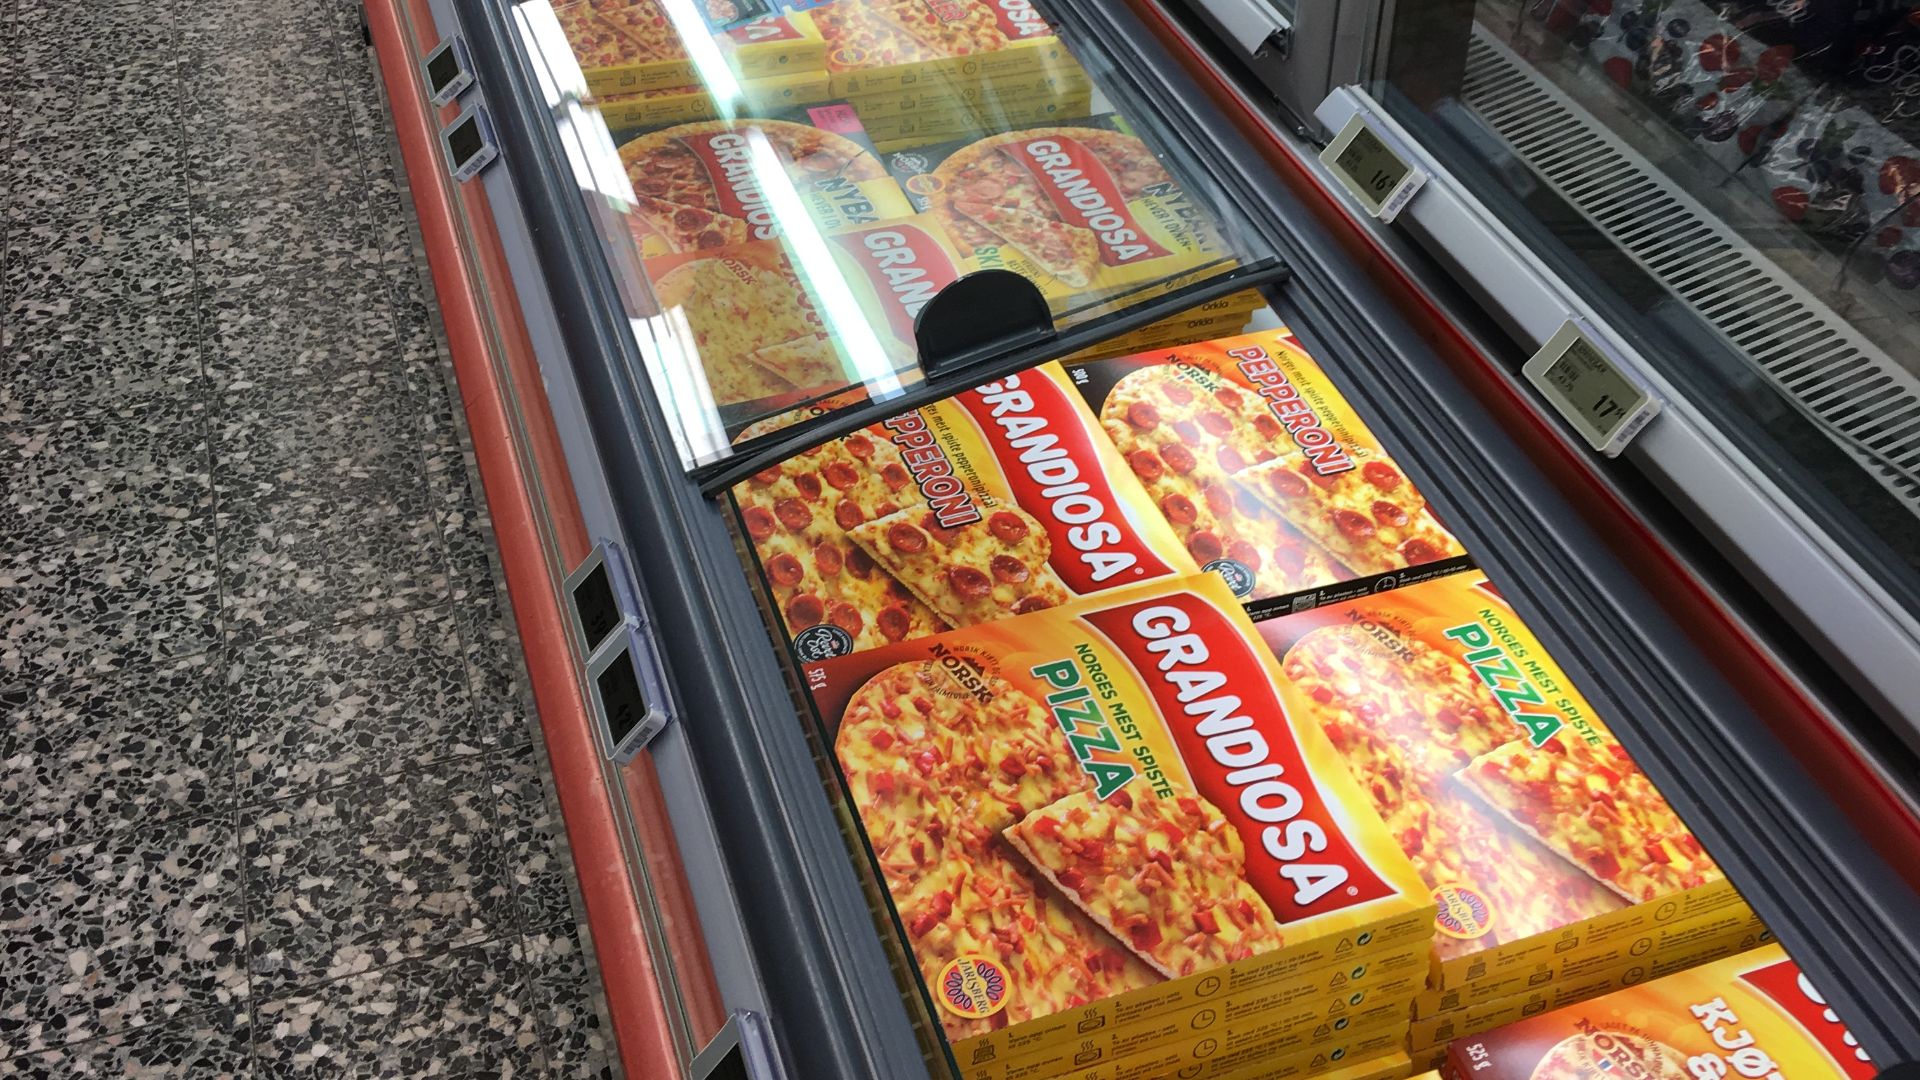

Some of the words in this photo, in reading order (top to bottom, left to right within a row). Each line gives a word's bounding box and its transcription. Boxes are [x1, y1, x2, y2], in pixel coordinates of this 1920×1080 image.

[1026, 139, 1149, 261] GRANDIOSA
[1202, 300, 1229, 311] Orkla
[1165, 354, 1220, 392] NORSK
[1292, 370, 1311, 386] mest
[934, 415, 951, 433] mest
[942, 430, 962, 452] spiste
[1227, 345, 1357, 475] PEPPERONI
[975, 374, 1137, 582] GRANDIOSA
[1344, 608, 1416, 664] NORSK
[928, 642, 993, 704] NORSK
[1444, 621, 1565, 748] PIZZA
[1479, 608, 1528, 660] NORGES
[1523, 660, 1561, 696] MEST
[1556, 698, 1604, 747] SPISTE
[1031, 658, 1137, 801] PIZZA
[1074, 643, 1118, 701] NORGES
[1109, 701, 1142, 741] MEST
[1133, 746, 1174, 800] SPISTE
[1132, 606, 1349, 905] GRANDIOSA
[957, 958, 990, 1013] JARLSBERG
[1466, 1043, 1489, 1061] 525
[1473, 1060, 1492, 1070] g
[1574, 1018, 1657, 1080] NORS
